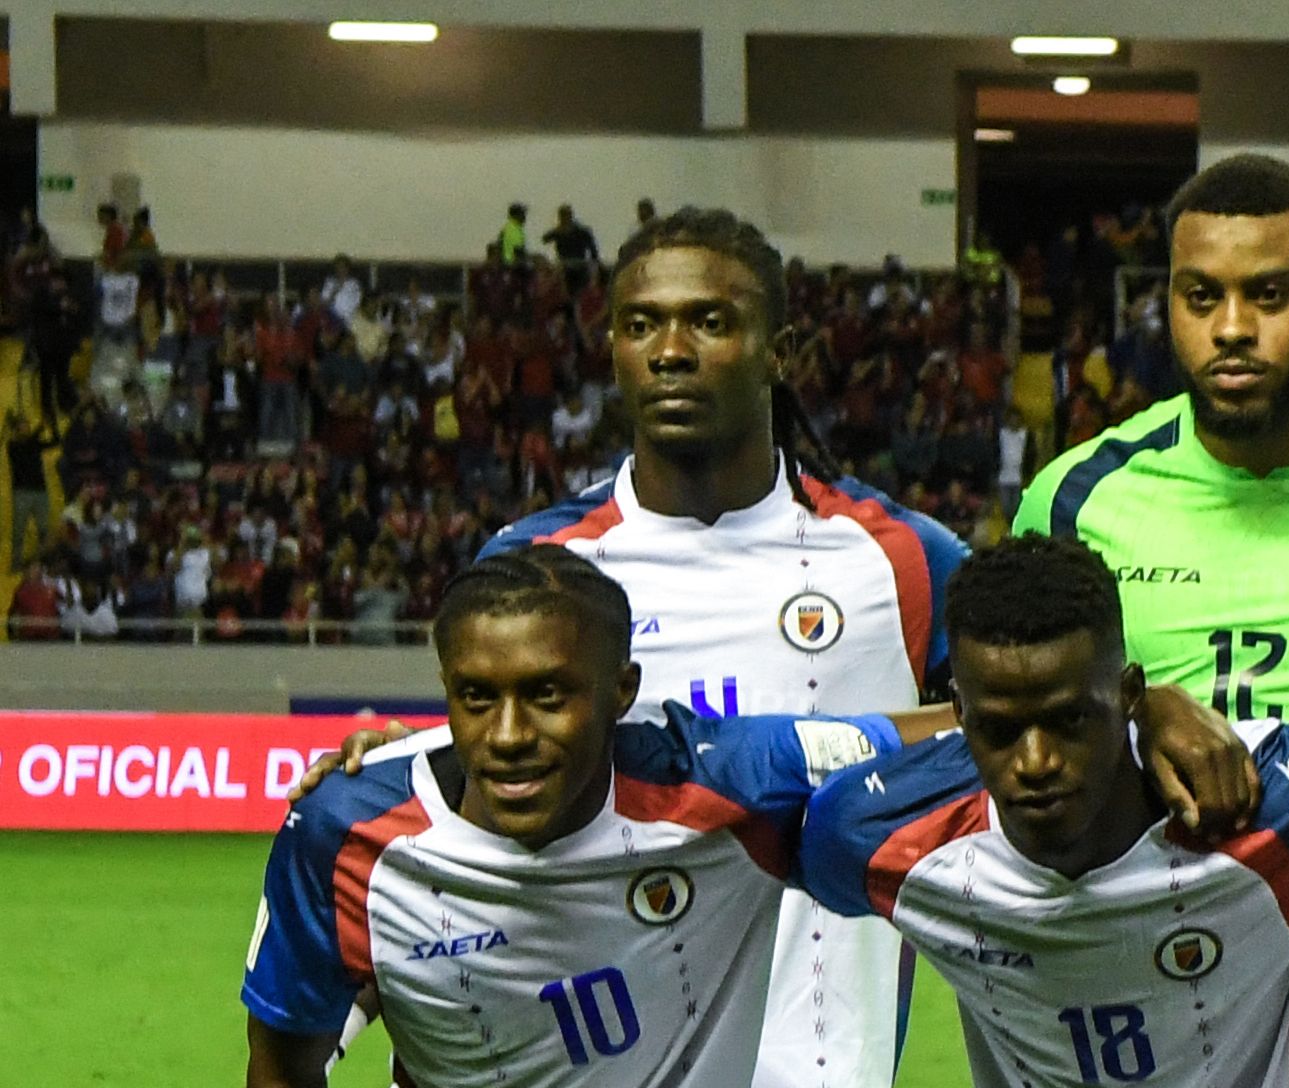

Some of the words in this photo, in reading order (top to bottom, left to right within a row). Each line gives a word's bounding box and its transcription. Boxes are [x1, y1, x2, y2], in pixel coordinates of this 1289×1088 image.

[1116, 566, 1200, 583] SAETA
[1208, 629, 1288, 720] 12
[18, 743, 247, 799] OFICIAL
[406, 930, 509, 961] SAETA
[539, 966, 641, 1065] 10
[1058, 1004, 1156, 1083] 18
